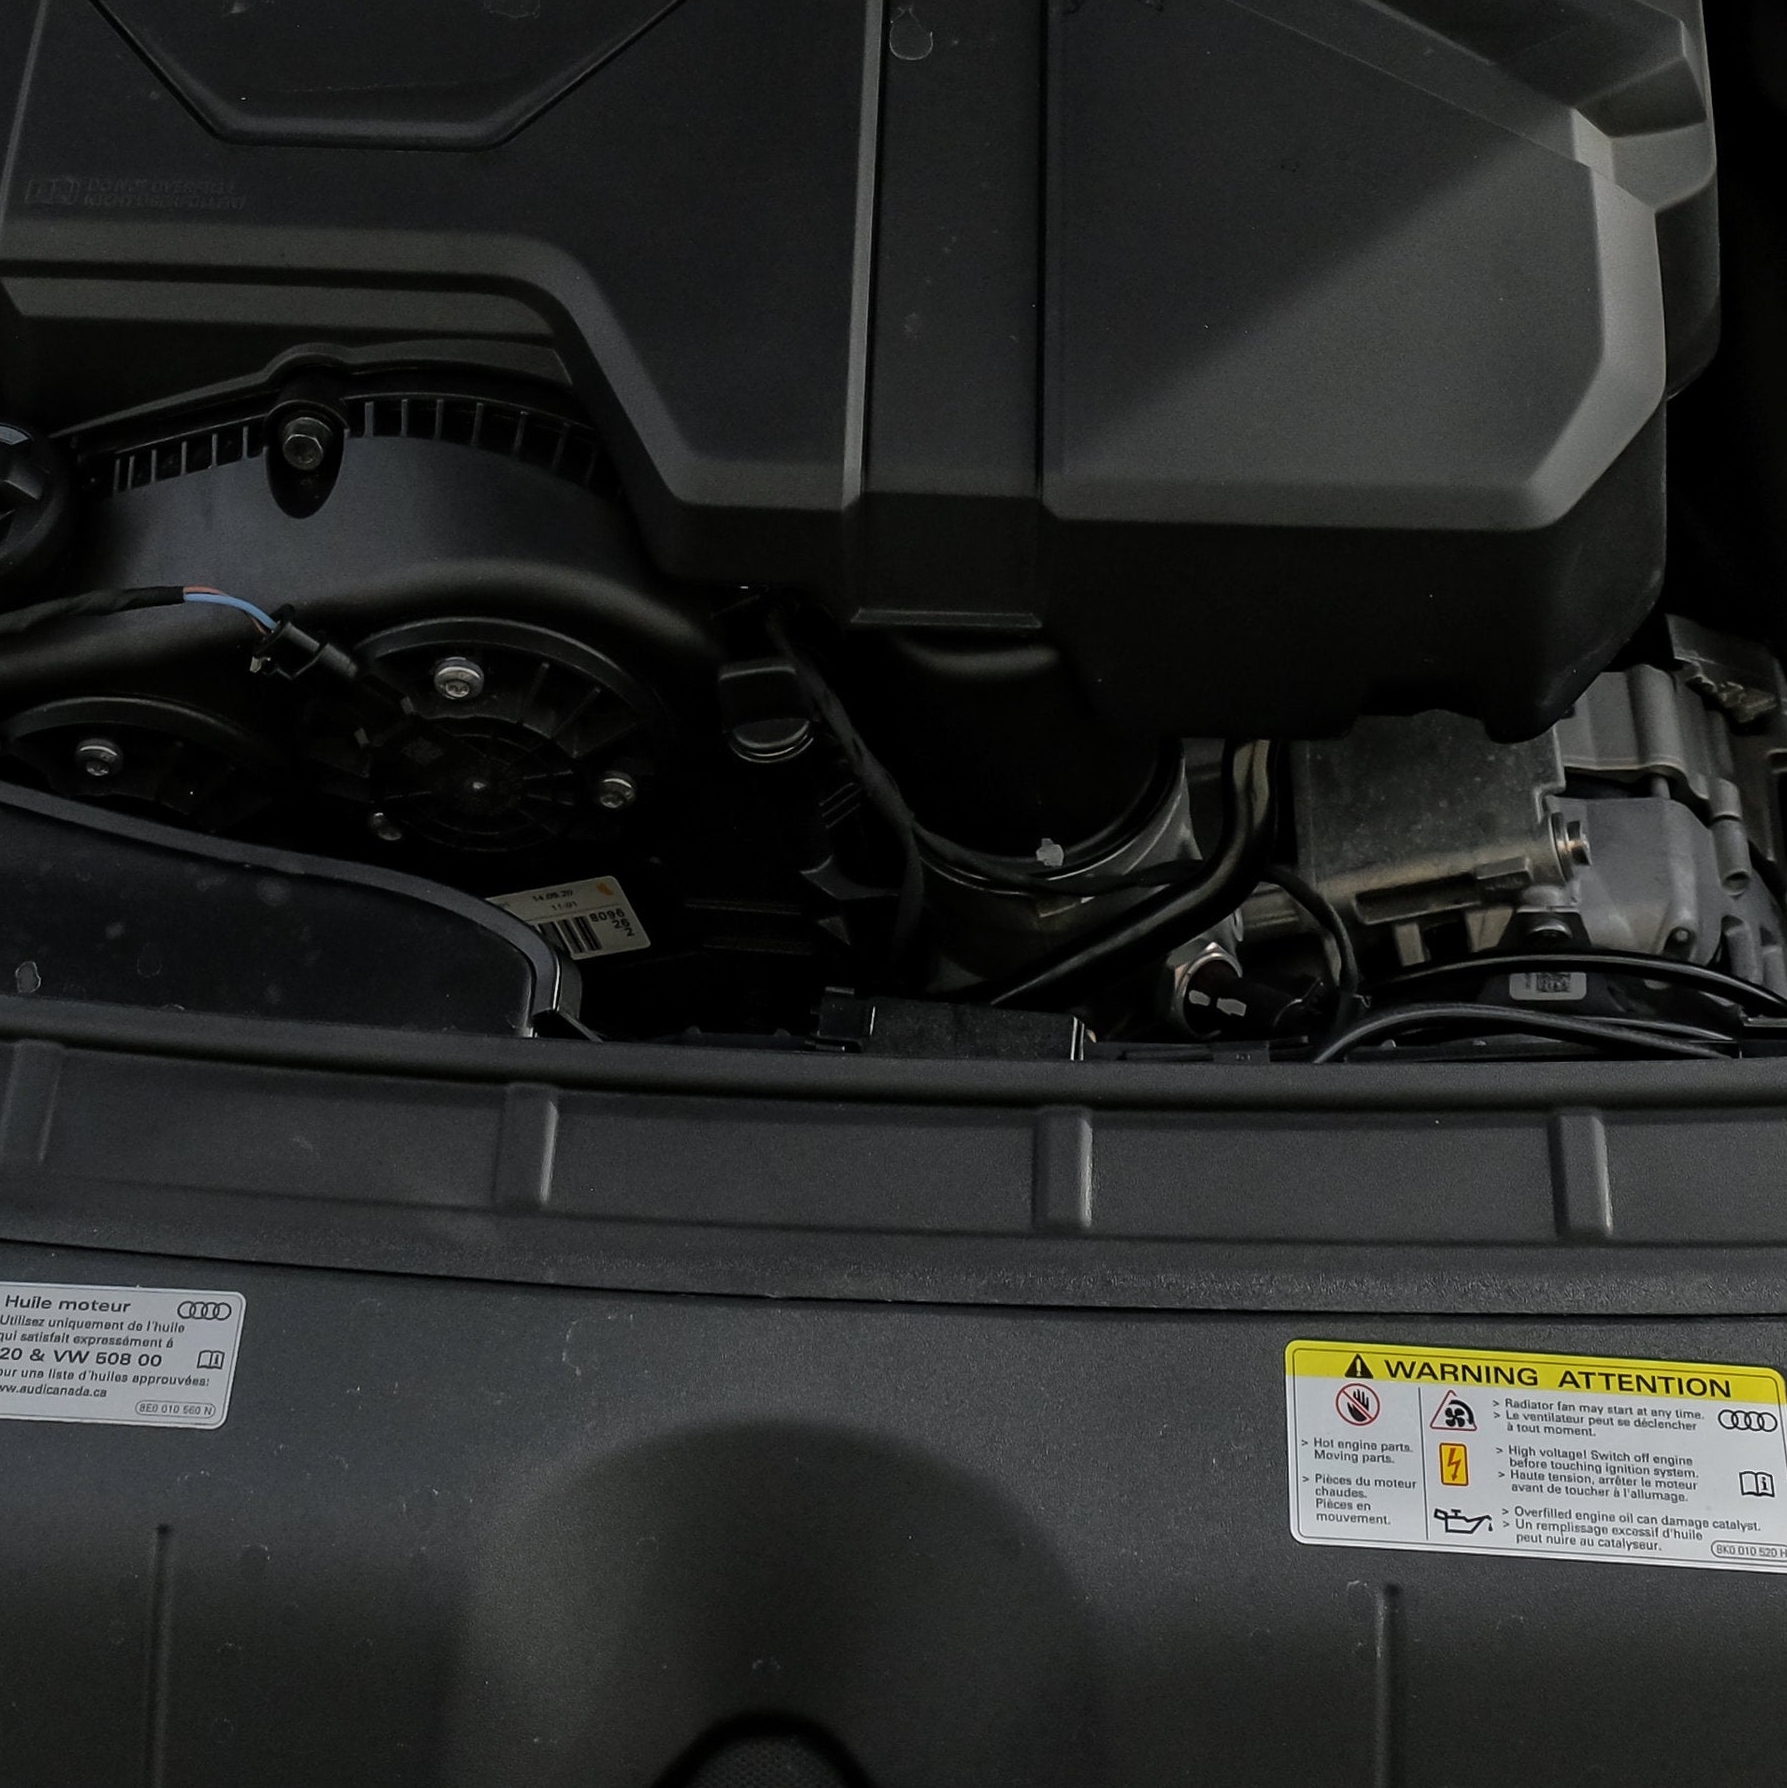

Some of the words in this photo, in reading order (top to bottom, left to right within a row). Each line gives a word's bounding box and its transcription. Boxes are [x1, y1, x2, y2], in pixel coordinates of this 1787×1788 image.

[5, 1294, 52, 1310] Huile
[58, 1299, 131, 1312] moteur
[0, 1314, 45, 1327] Utilisez
[48, 1317, 124, 1331] uniquement
[128, 1320, 143, 1331] de
[20, 1331, 70, 1343] satisfait
[29, 1348, 45, 1362] &
[53, 1349, 90, 1364] VW
[137, 1353, 162, 1367] 00
[21, 1368, 44, 1378] une
[48, 1367, 74, 1380] liste
[1384, 1359, 1538, 1386] WARNING
[1558, 1370, 1731, 1398] ATTENTION
[1505, 1398, 1554, 1411] Radiator
[1557, 1400, 1574, 1412] fan
[1579, 1403, 1604, 1416] may
[1608, 1404, 1633, 1416] start
[1637, 1406, 1647, 1416] at
[1651, 1408, 1672, 1420] any
[1675, 1408, 1705, 1420] time.
[1506, 1410, 1520, 1420] Le
[1523, 1410, 1584, 1424] ventilateur
[1588, 1415, 1614, 1427] peut
[1617, 1418, 1631, 1427] se
[1634, 1417, 1697, 1431] déclencher
[1517, 1423, 1540, 1434] tout
[1544, 1425, 1596, 1437] moment.
[1313, 1437, 1334, 1448] Hot
[1337, 1439, 1377, 1452] engine
[1381, 1442, 1413, 1454] parts.
[1314, 1449, 1358, 1463] Moving
[1362, 1453, 1395, 1464] parts.
[1509, 1444, 1536, 1458] High
[1591, 1450, 1631, 1462] Switch
[1634, 1452, 1650, 1463] off
[1653, 1455, 1693, 1467] engine
[1510, 1457, 1547, 1469] before
[1550, 1460, 1602, 1474] touching
[1606, 1463, 1650, 1476] ignition
[1653, 1467, 1699, 1479] system.
[1315, 1473, 1352, 1485] Pièces
[1355, 1476, 1370, 1487] du
[1374, 1478, 1417, 1489] moteur
[1511, 1469, 1545, 1481] Haute
[1548, 1472, 1595, 1485] tension,
[1598, 1474, 1637, 1487] arrêter
[1641, 1476, 1652, 1488] le
[1655, 1479, 1698, 1491] moteur
[1315, 1486, 1367, 1499] chaudes.
[1511, 1482, 1544, 1493] avant
[1547, 1484, 1562, 1495] de
[1565, 1485, 1610, 1497] toucher
[1623, 1488, 1688, 1504] l'allumage.
[1316, 1498, 1353, 1510] Pièces
[1356, 1502, 1371, 1511] en
[1316, 1512, 1391, 1525] mouvement.
[1514, 1506, 1572, 1520] Overfilled
[1575, 1511, 1615, 1524] engine
[1619, 1512, 1633, 1524] oil
[1637, 1515, 1658, 1525] can
[1661, 1515, 1709, 1529] damage
[1712, 1519, 1761, 1532] catalyst.
[1515, 1519, 1532, 1530] Un
[1536, 1520, 1608, 1536] remplissage
[1612, 1525, 1659, 1538] excessif
[1662, 1526, 1703, 1541] d'huile
[1516, 1532, 1543, 1544] peut
[1546, 1534, 1576, 1546] nuire
[1579, 1537, 1594, 1547] au
[1598, 1537, 1662, 1552] catalyseur.
